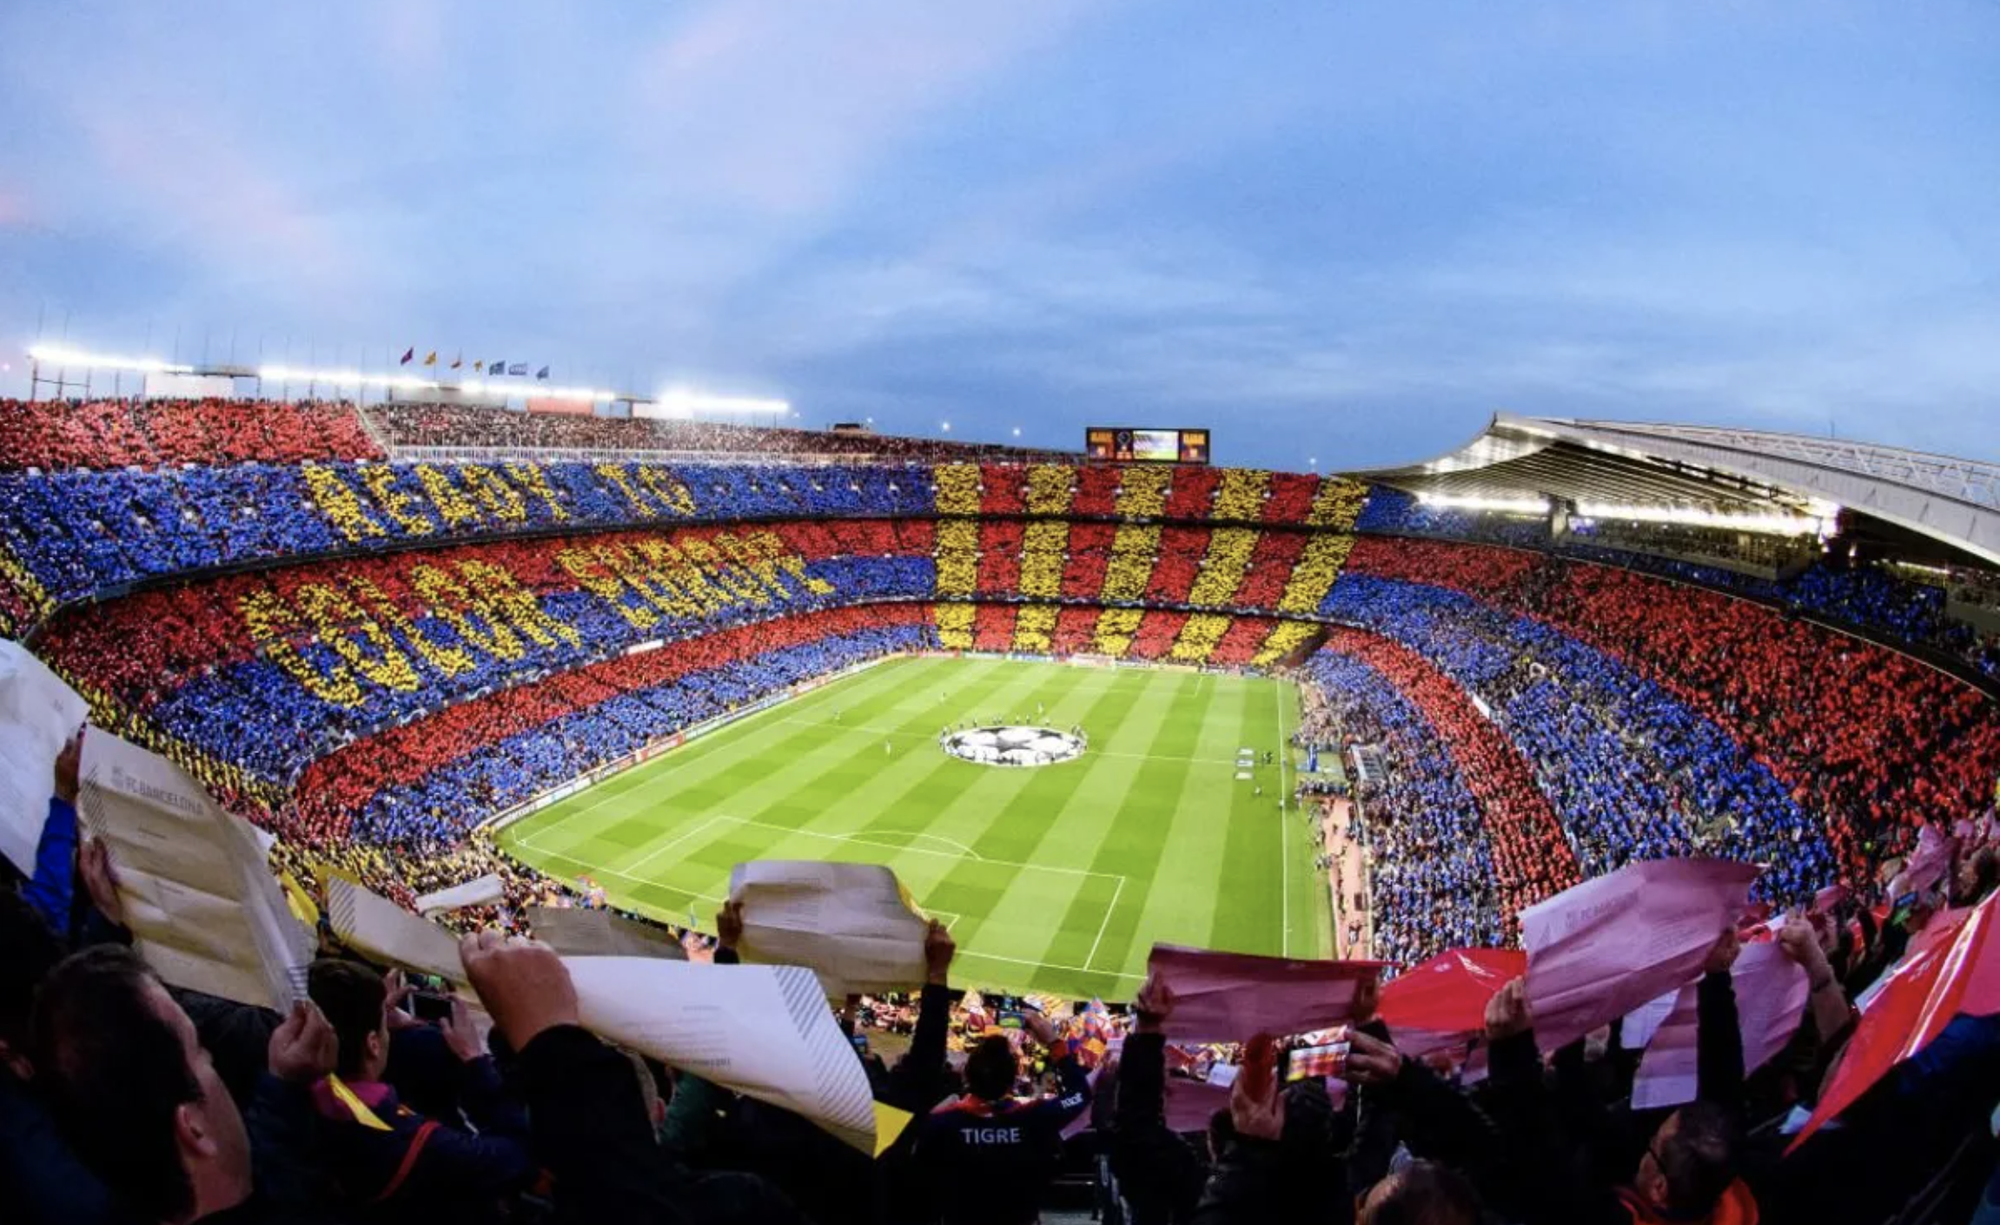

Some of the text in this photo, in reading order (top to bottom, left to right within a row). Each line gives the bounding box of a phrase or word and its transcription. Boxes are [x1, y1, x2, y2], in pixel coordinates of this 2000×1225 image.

[238, 558, 583, 708] COLOR
[139, 779, 204, 816] BARCELONA
[961, 1127, 1021, 1144] TIGRE
